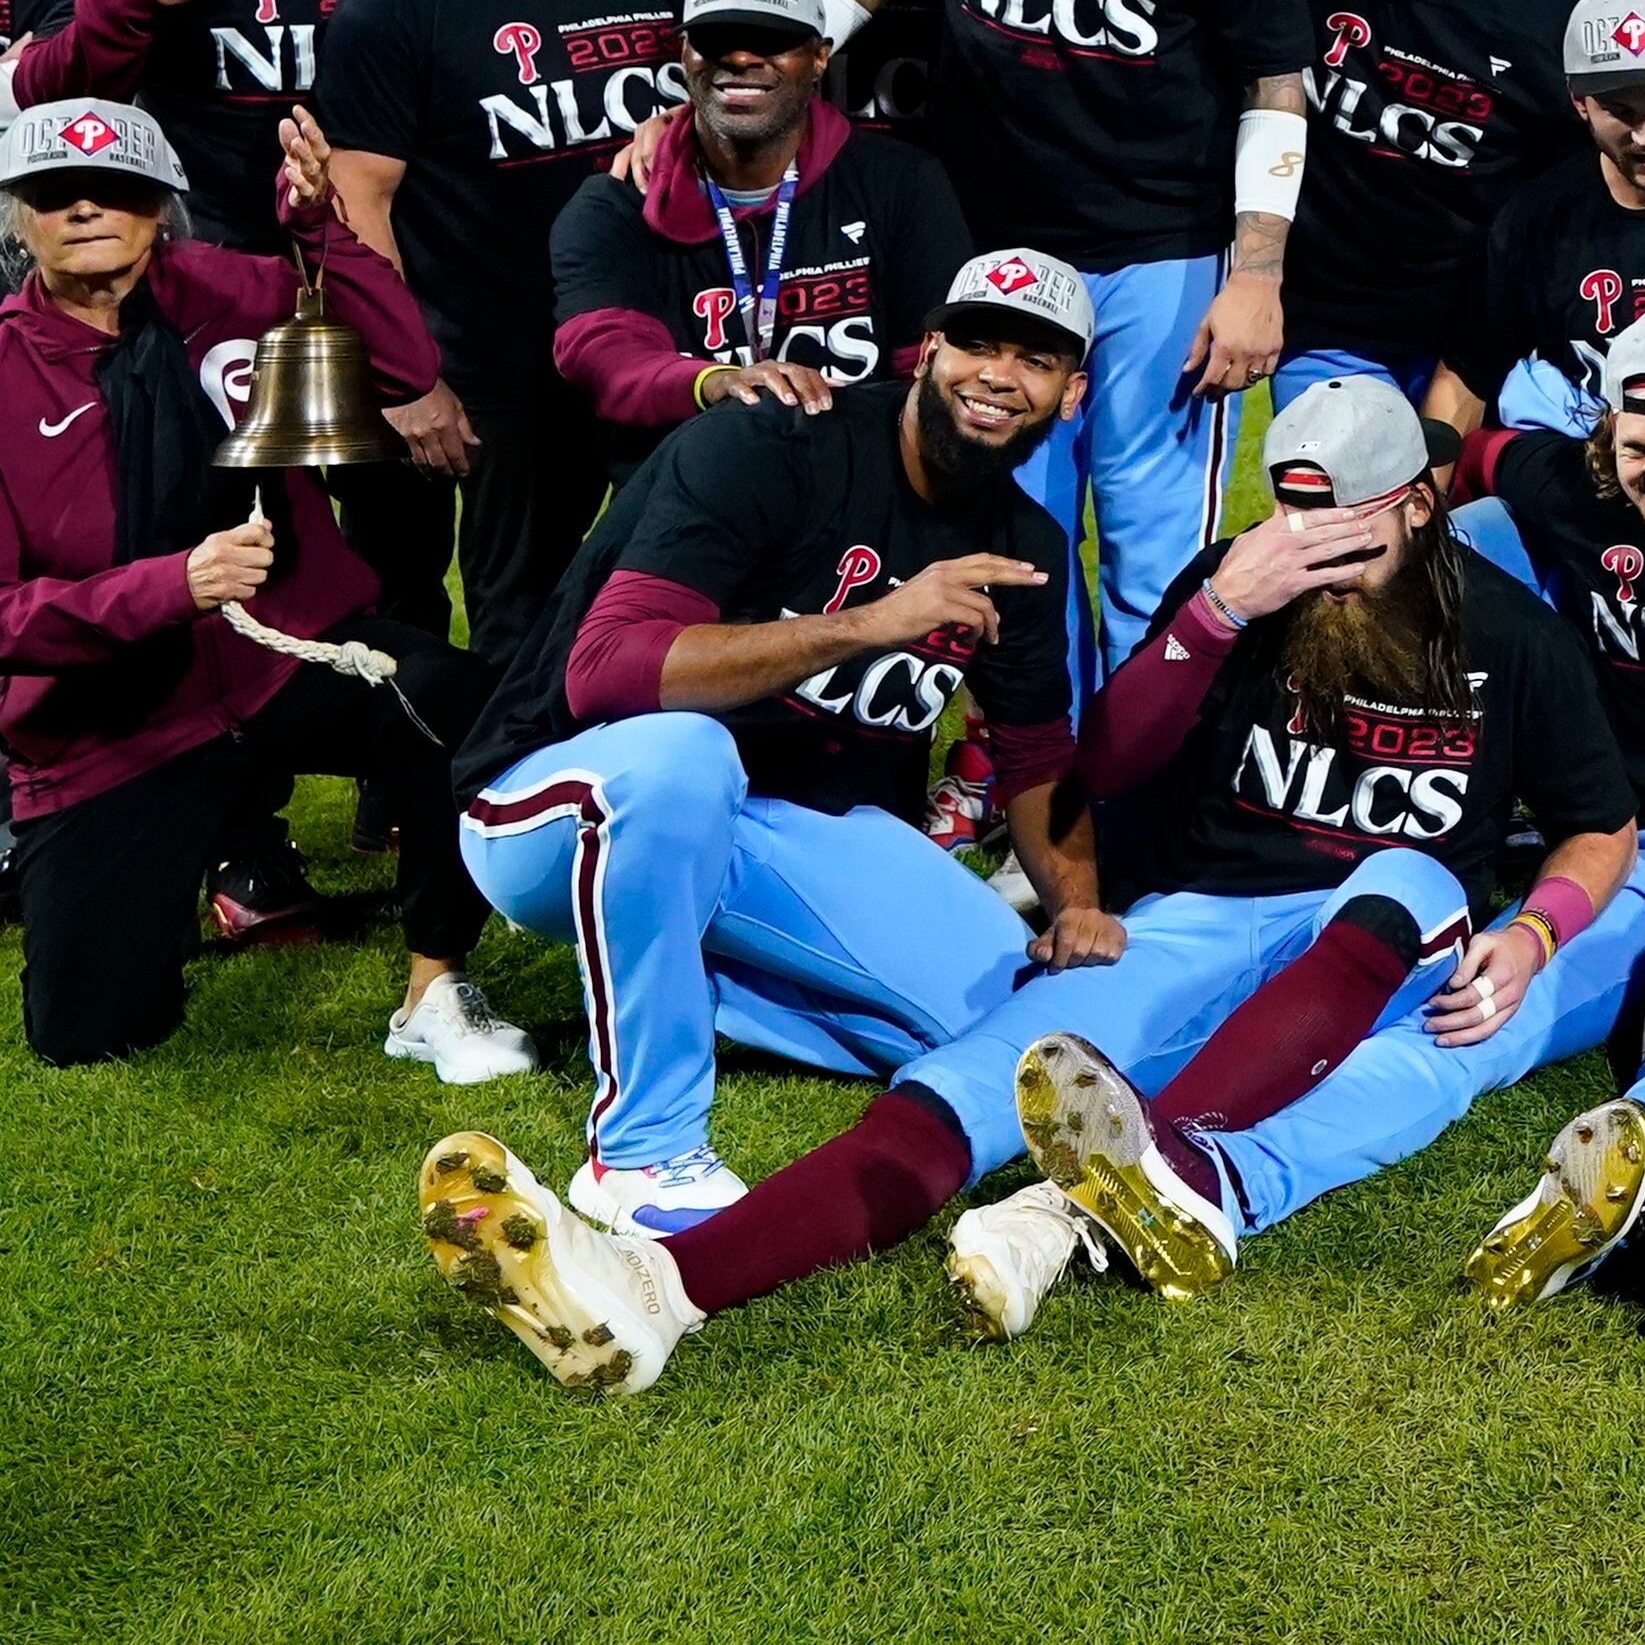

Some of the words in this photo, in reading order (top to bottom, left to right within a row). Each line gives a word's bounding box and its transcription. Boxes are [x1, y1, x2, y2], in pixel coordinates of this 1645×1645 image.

[493, 21, 543, 85] P
[557, 13, 633, 34] PHILADELPHIA
[1326, 11, 1372, 68] P
[1302, 66, 1486, 168] NLCS
[716, 205, 746, 276] PHILADELPHIA
[767, 199, 789, 271] PHILADELPHIA
[693, 287, 737, 350] P
[1579, 269, 1623, 333] P
[823, 544, 881, 615] P
[1600, 544, 1644, 602] P
[795, 651, 965, 733] LCS
[1347, 715, 1480, 758] 2023
[1232, 722, 1468, 840] NLCS
[623, 1249, 661, 1315] ADIZERO
